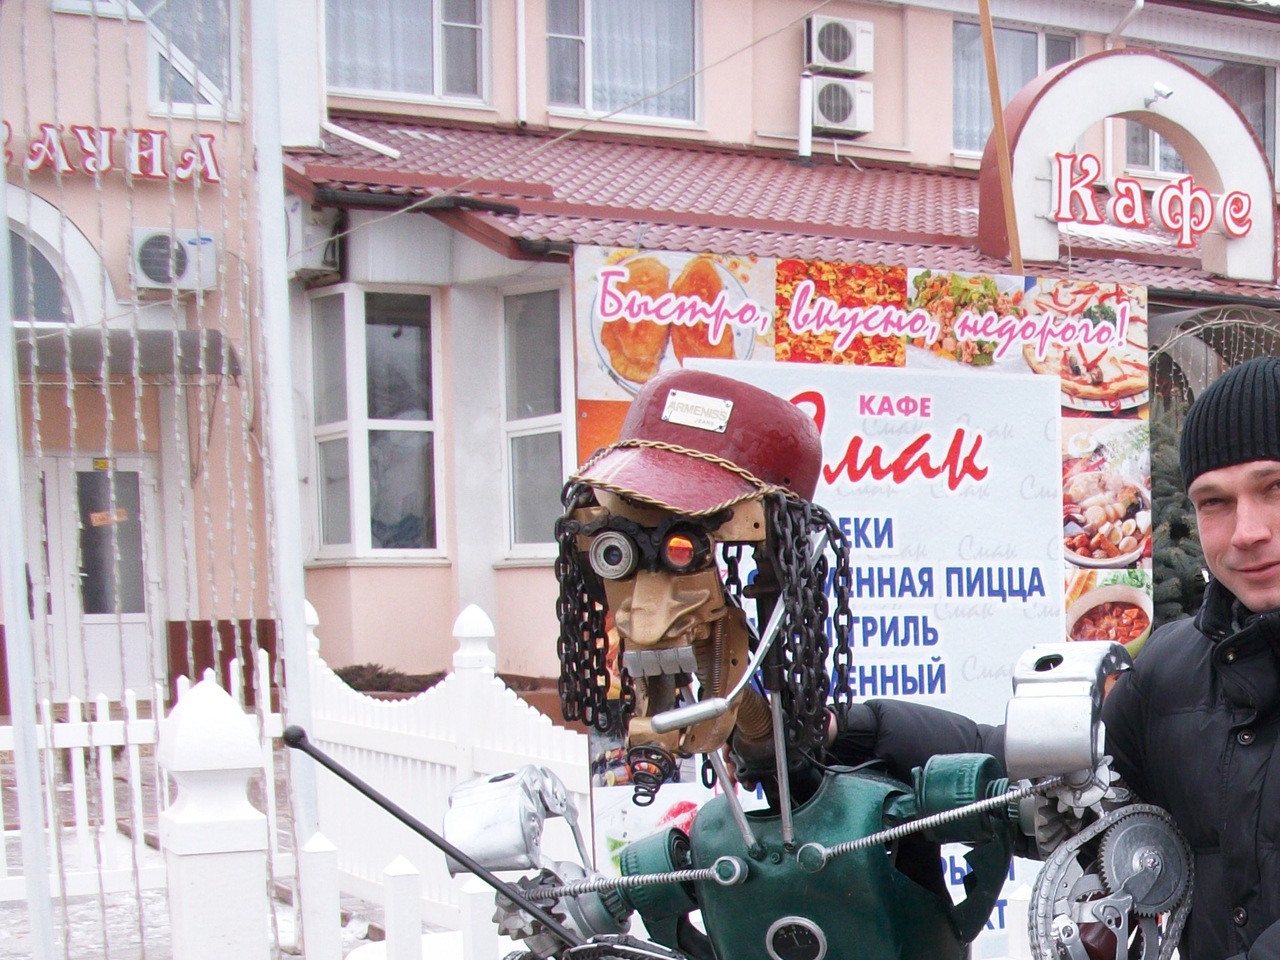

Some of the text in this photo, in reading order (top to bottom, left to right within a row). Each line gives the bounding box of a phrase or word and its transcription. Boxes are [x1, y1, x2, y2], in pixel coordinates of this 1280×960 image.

[1053, 151, 1253, 248] Кафе
[599, 269, 1128, 358] Быстро, вкусно, недорого!
[858, 394, 931, 418] КАФЕ
[944, 566, 1047, 602] ПИЦЦА
